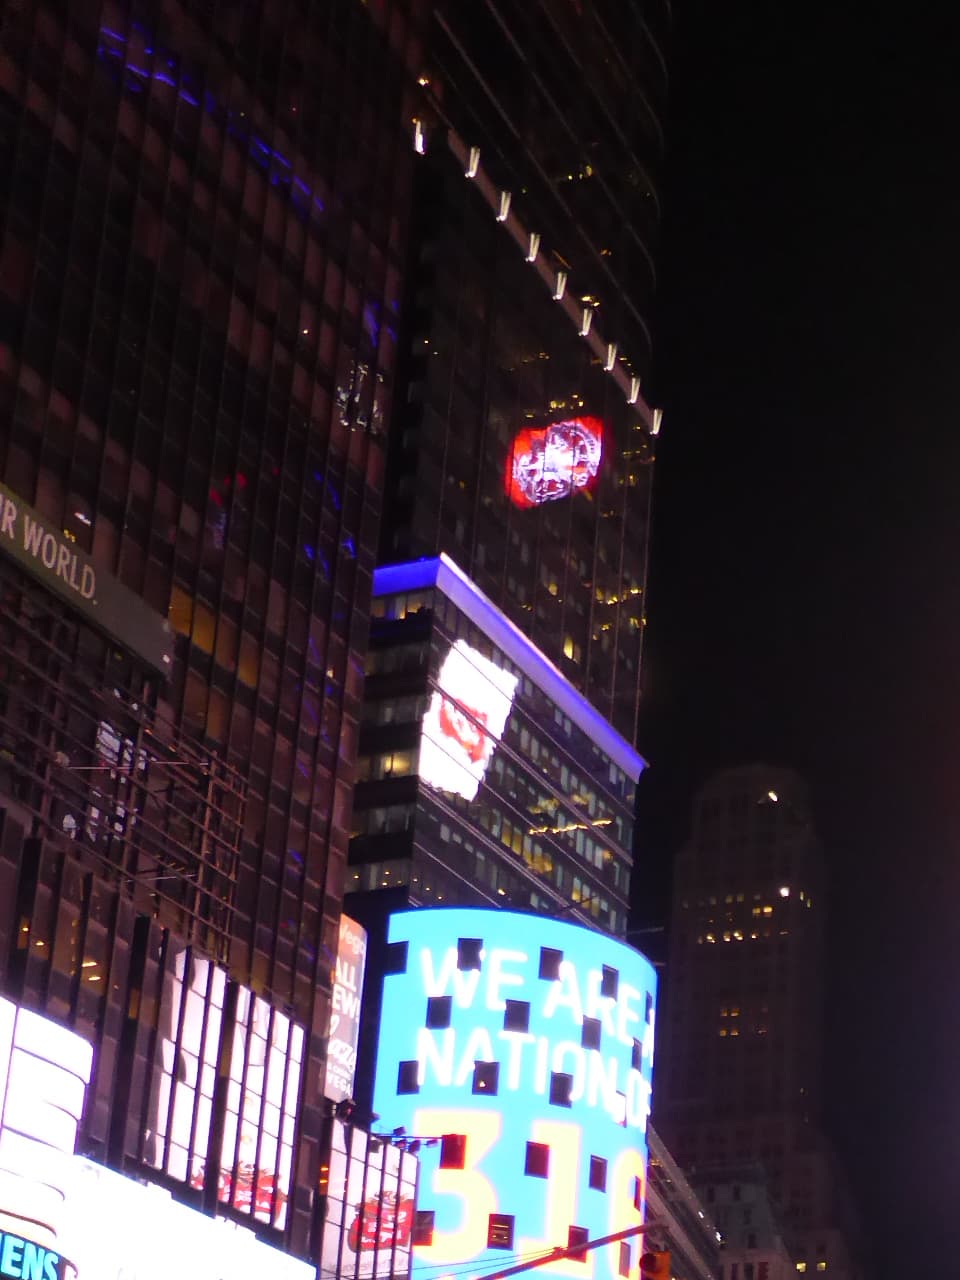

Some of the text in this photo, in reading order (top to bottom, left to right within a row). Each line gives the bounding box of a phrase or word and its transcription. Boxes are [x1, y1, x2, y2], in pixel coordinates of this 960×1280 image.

[23, 514, 99, 605] WORLD.
[332, 984, 361, 1024] EW!
[420, 946, 529, 1011] WE
[542, 960, 642, 1048] ARE
[416, 1027, 622, 1110] NATION
